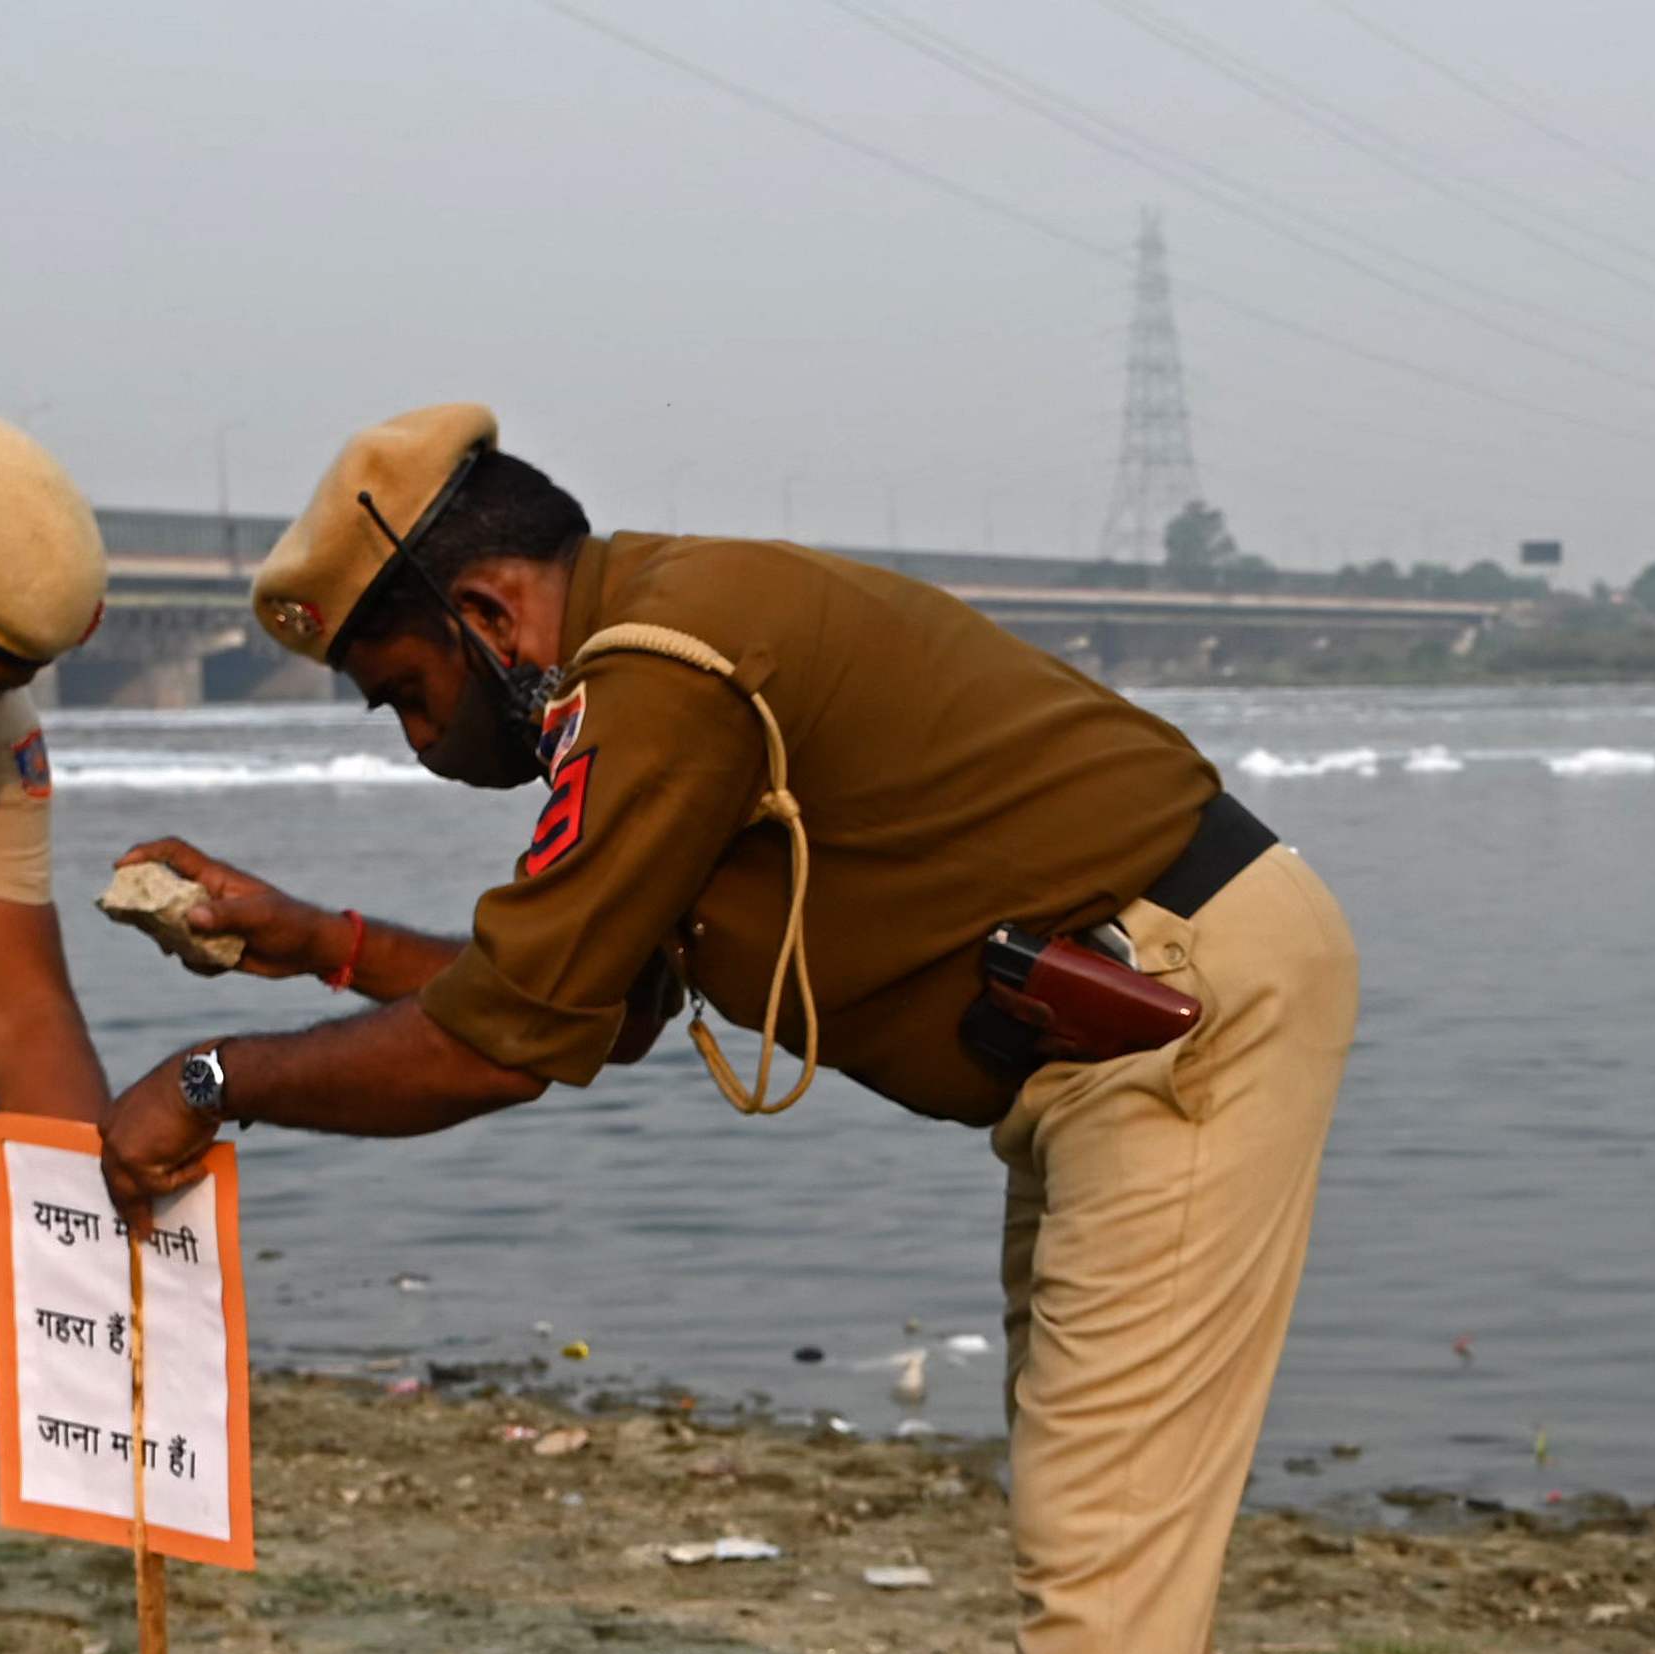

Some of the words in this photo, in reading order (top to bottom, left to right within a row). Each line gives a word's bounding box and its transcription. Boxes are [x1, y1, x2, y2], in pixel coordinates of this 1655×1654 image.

[33, 1201, 100, 1246] यमुना
[36, 1308, 97, 1348] गहरा
[37, 1415, 100, 1455] जाना
